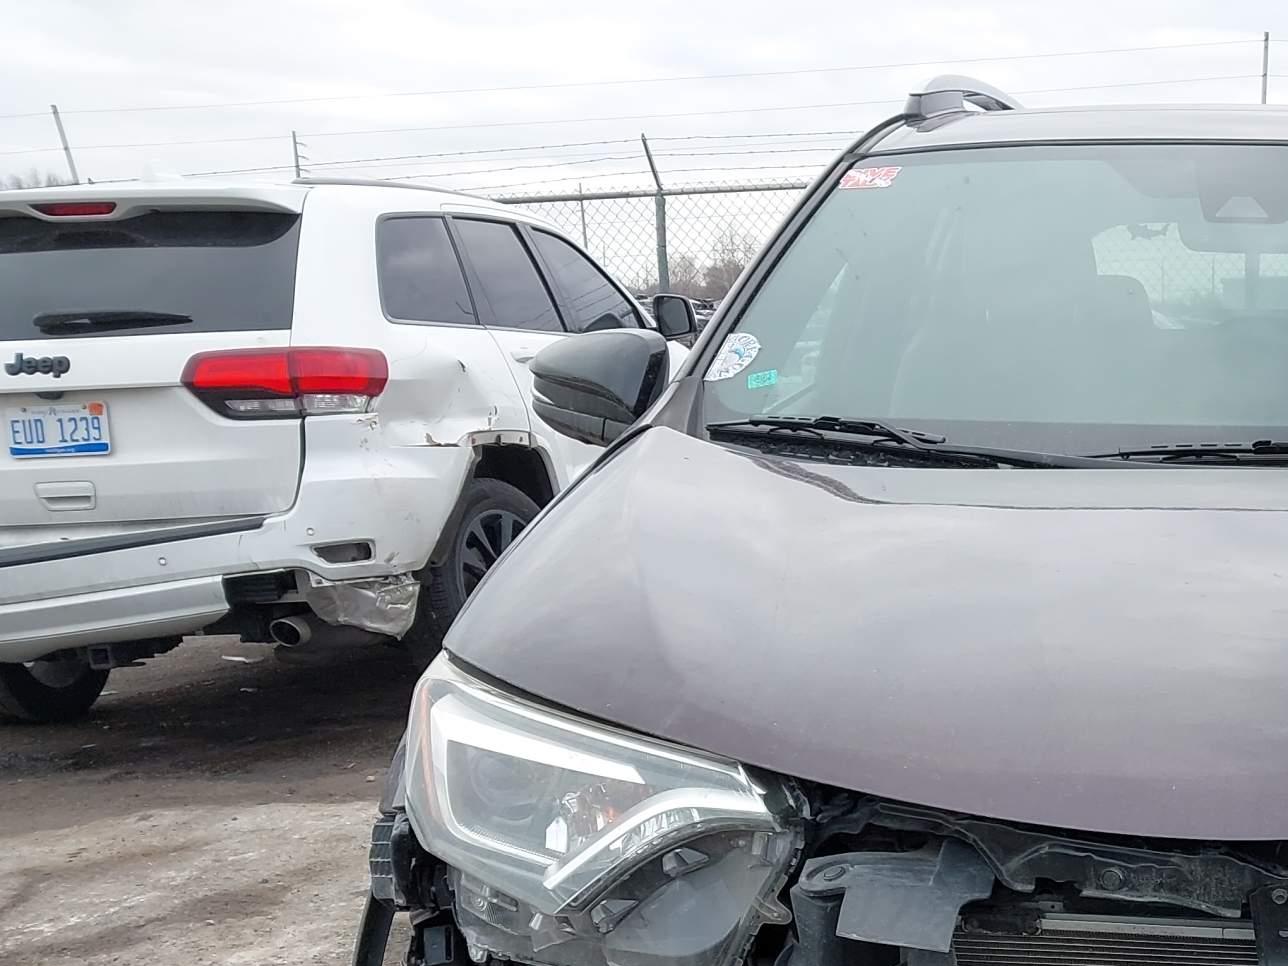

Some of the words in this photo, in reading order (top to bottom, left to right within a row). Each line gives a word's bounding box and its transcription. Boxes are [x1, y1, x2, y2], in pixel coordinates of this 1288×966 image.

[4, 353, 71, 378] Jeep
[10, 418, 46, 444] EUD
[56, 416, 102, 443] 1239
